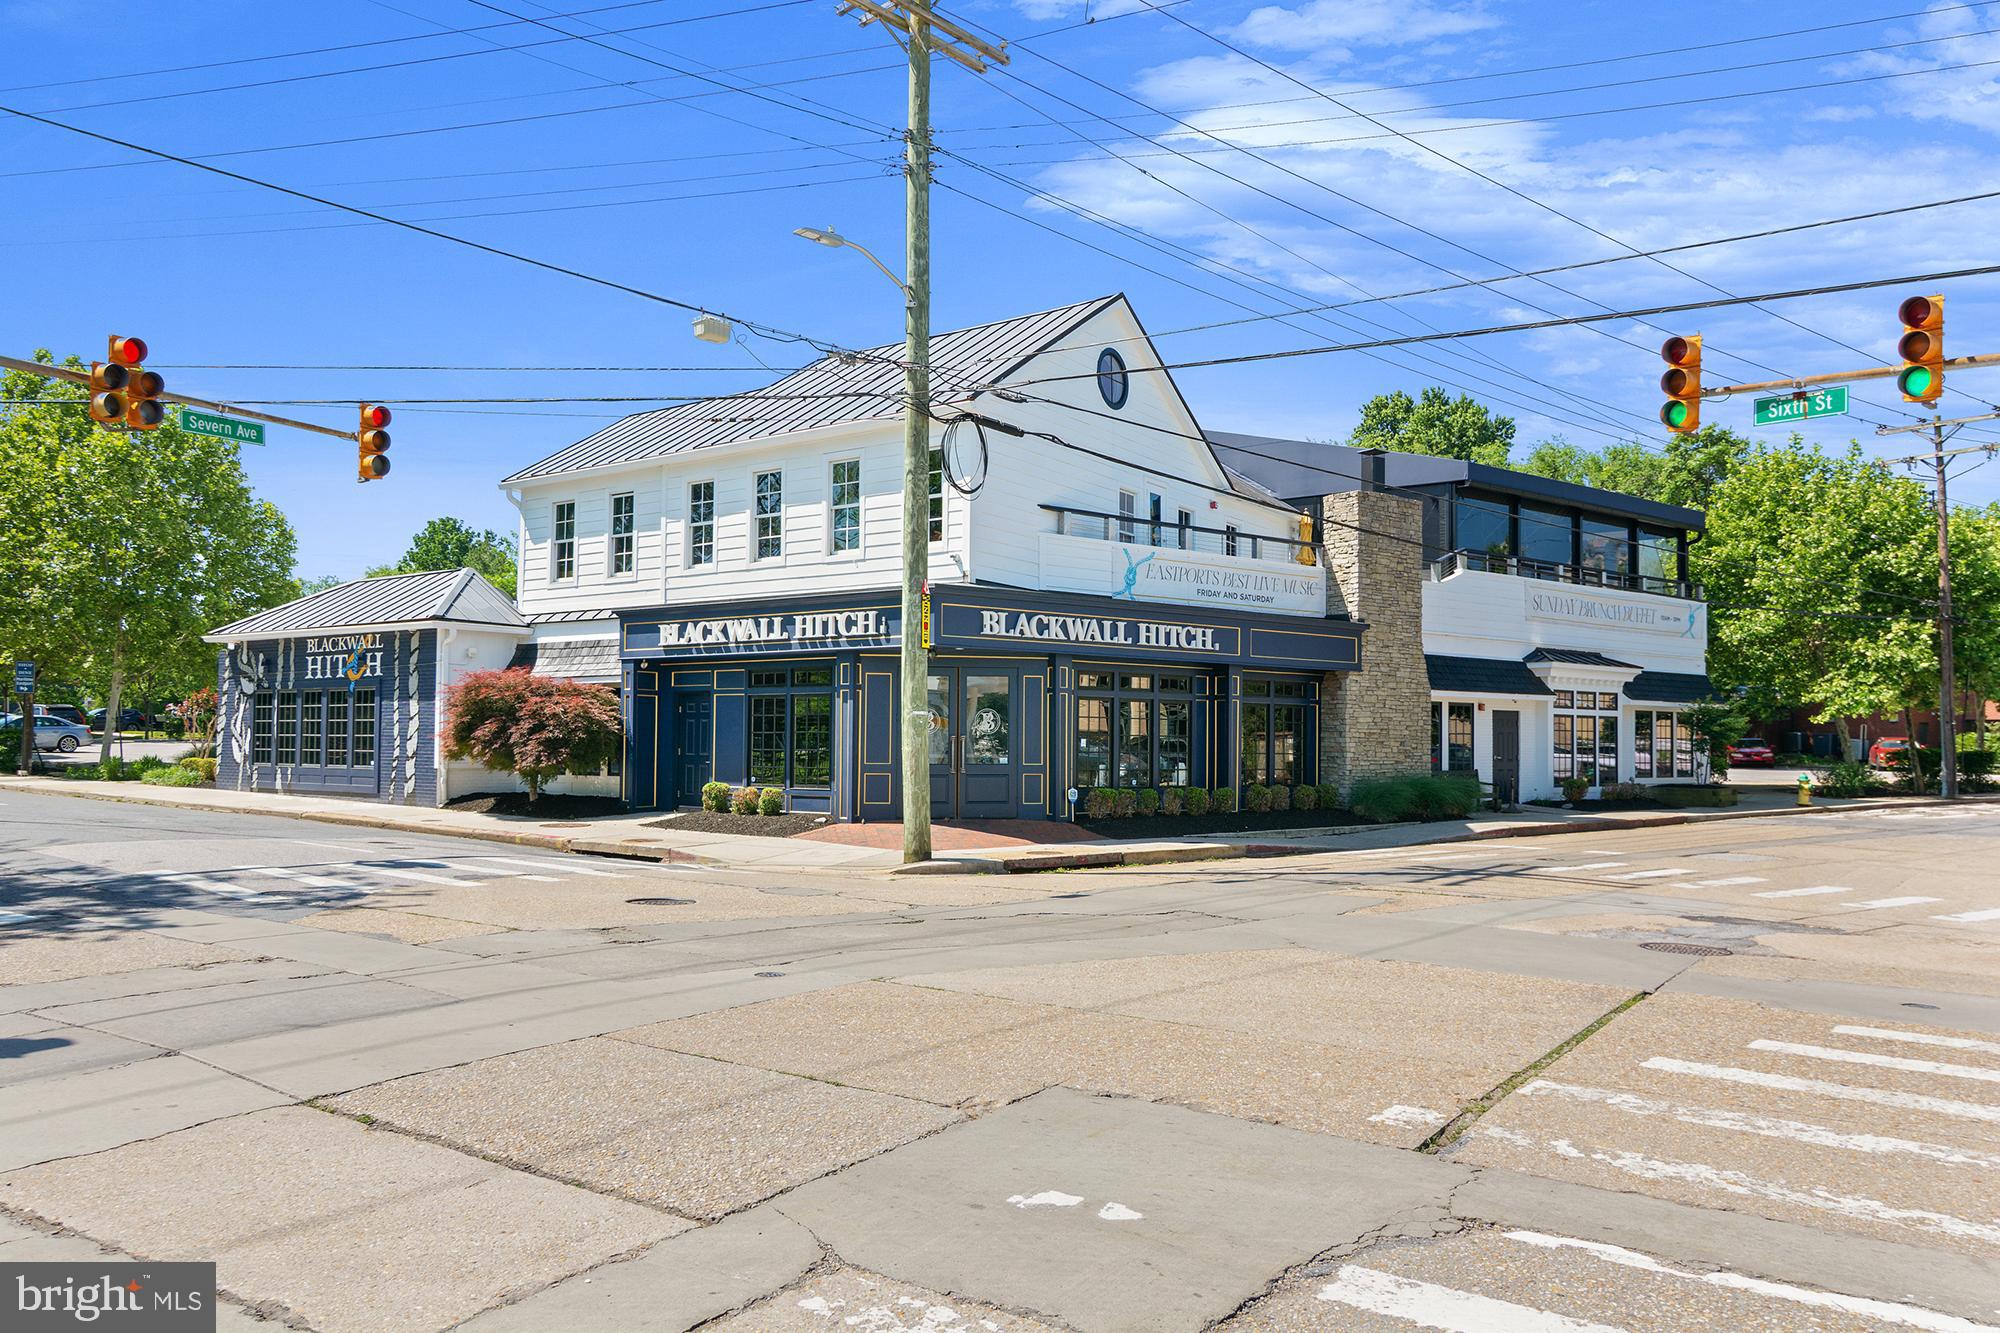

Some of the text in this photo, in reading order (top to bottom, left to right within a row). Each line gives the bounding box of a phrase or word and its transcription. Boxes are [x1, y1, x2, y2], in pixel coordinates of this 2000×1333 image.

[1768, 394, 1833, 418] Sixth St
[189, 415, 257, 439] Severn Ave
[1222, 571, 1251, 590] BEST
[1253, 575, 1280, 593] LIVE
[1282, 578, 1320, 596] MUSIC
[1196, 588, 1275, 604] FRIDAY AND SATURDAY
[1533, 594, 1578, 616] SUNDAY
[1579, 600, 1621, 620] BRUNCH
[658, 616, 789, 647] BLACKWALL
[980, 610, 1220, 651] BLACKWALL HITCH.
[306, 633, 384, 653] BLACKWALL
